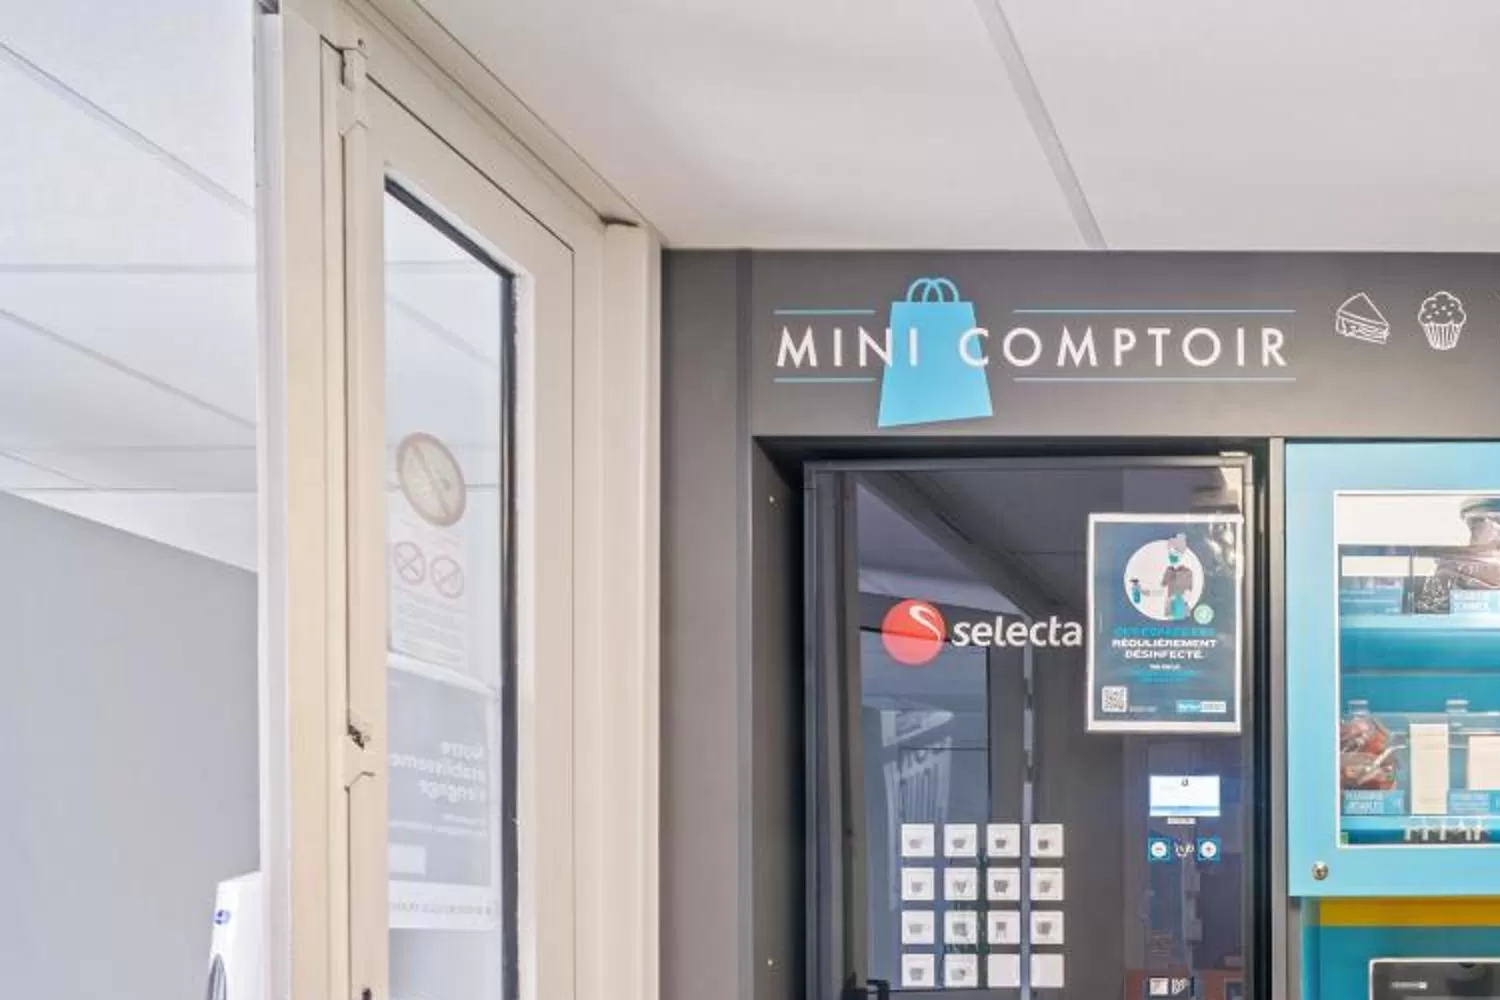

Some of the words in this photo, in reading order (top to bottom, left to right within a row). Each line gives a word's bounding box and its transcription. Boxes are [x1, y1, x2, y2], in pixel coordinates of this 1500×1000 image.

[774, 326, 920, 368] MINI
[958, 326, 1289, 368] COMPTOIR
[952, 615, 1083, 647] selecta
